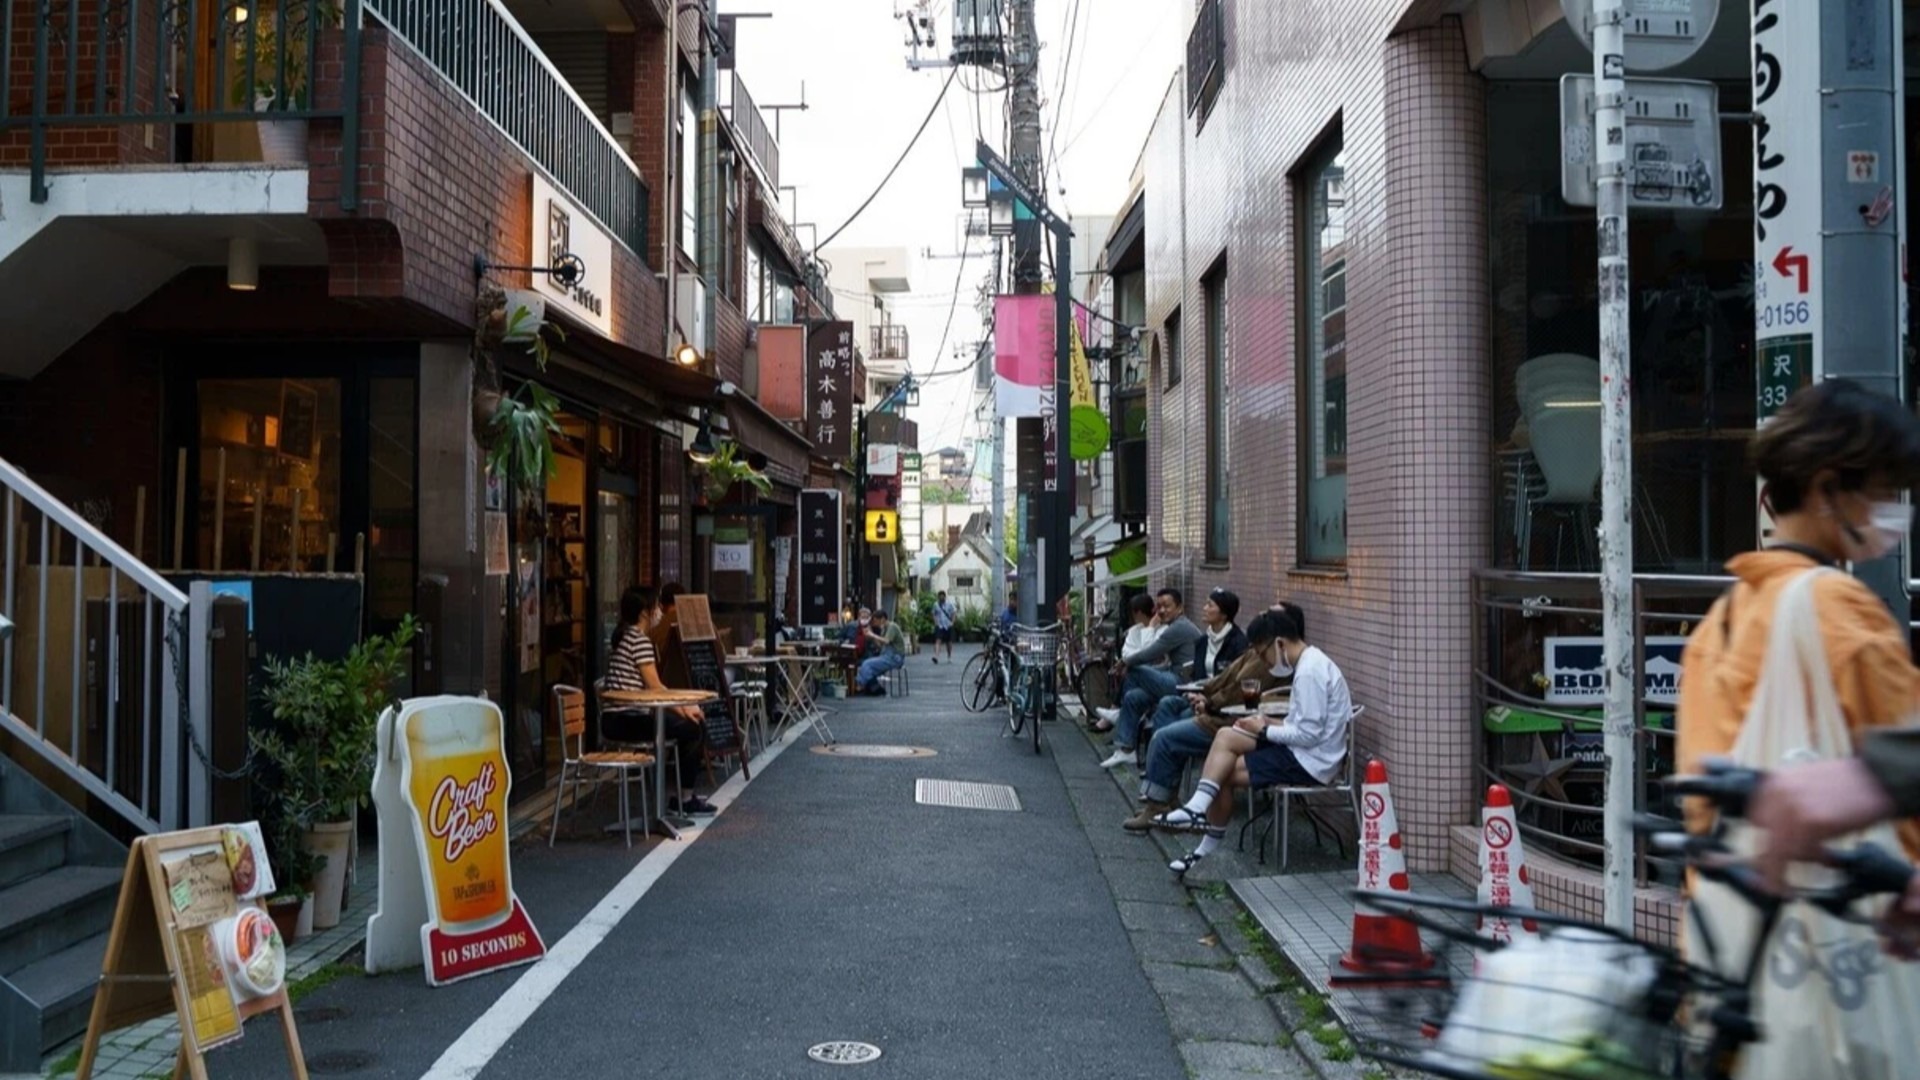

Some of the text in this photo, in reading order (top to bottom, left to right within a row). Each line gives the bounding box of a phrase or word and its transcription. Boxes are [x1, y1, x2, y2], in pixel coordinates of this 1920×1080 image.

[817, 349, 837, 444] 高木善行
[1572, 749, 1603, 762] pata
[429, 763, 495, 838] Craft
[445, 809, 497, 862] Beer
[1570, 817, 1601, 834] ARC
[441, 931, 527, 967] 10 SECONDS
